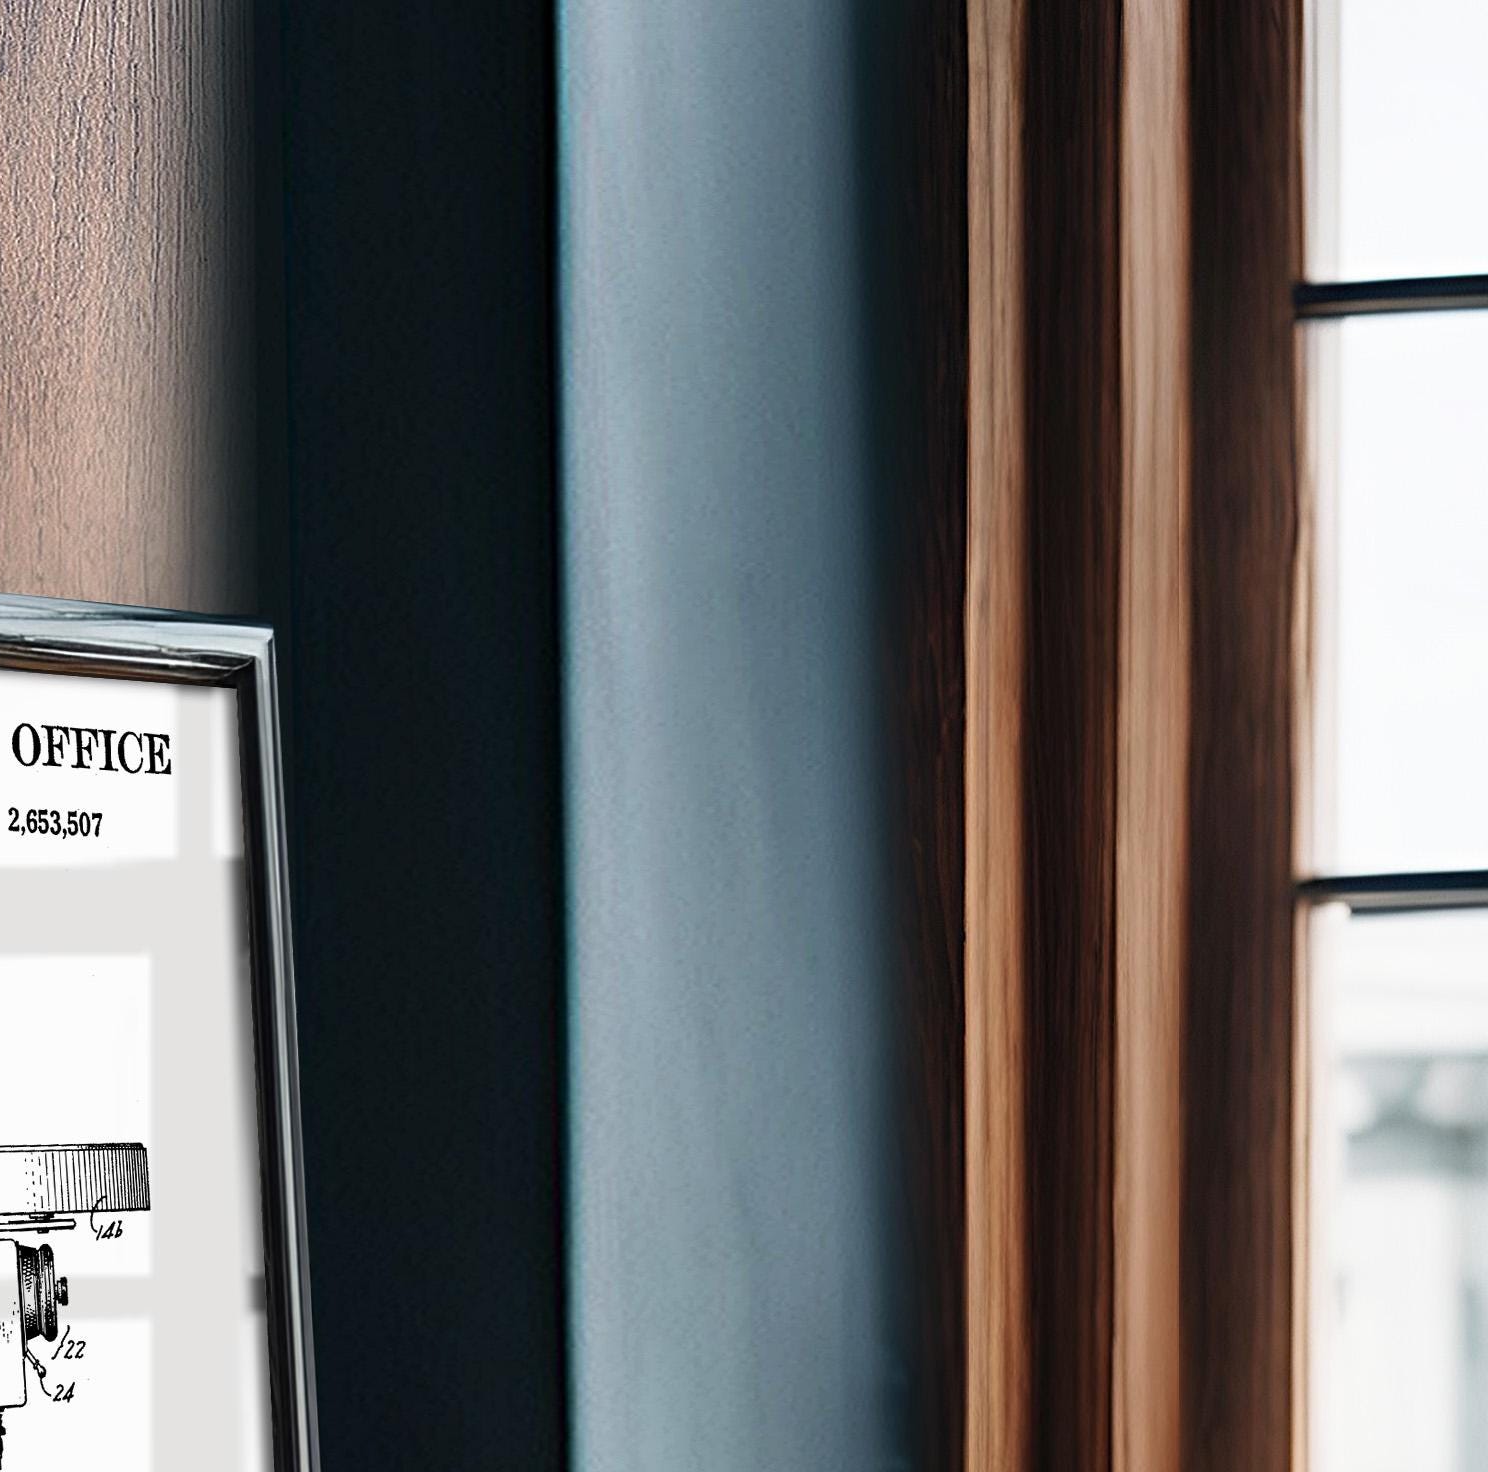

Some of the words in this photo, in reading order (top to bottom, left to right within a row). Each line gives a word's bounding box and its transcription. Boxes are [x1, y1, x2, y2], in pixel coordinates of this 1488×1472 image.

[12, 723, 173, 776] OFFICE
[7, 807, 104, 839] 2,653,507
[64, 1340, 86, 1359] 22
[53, 1381, 75, 1402] 24
